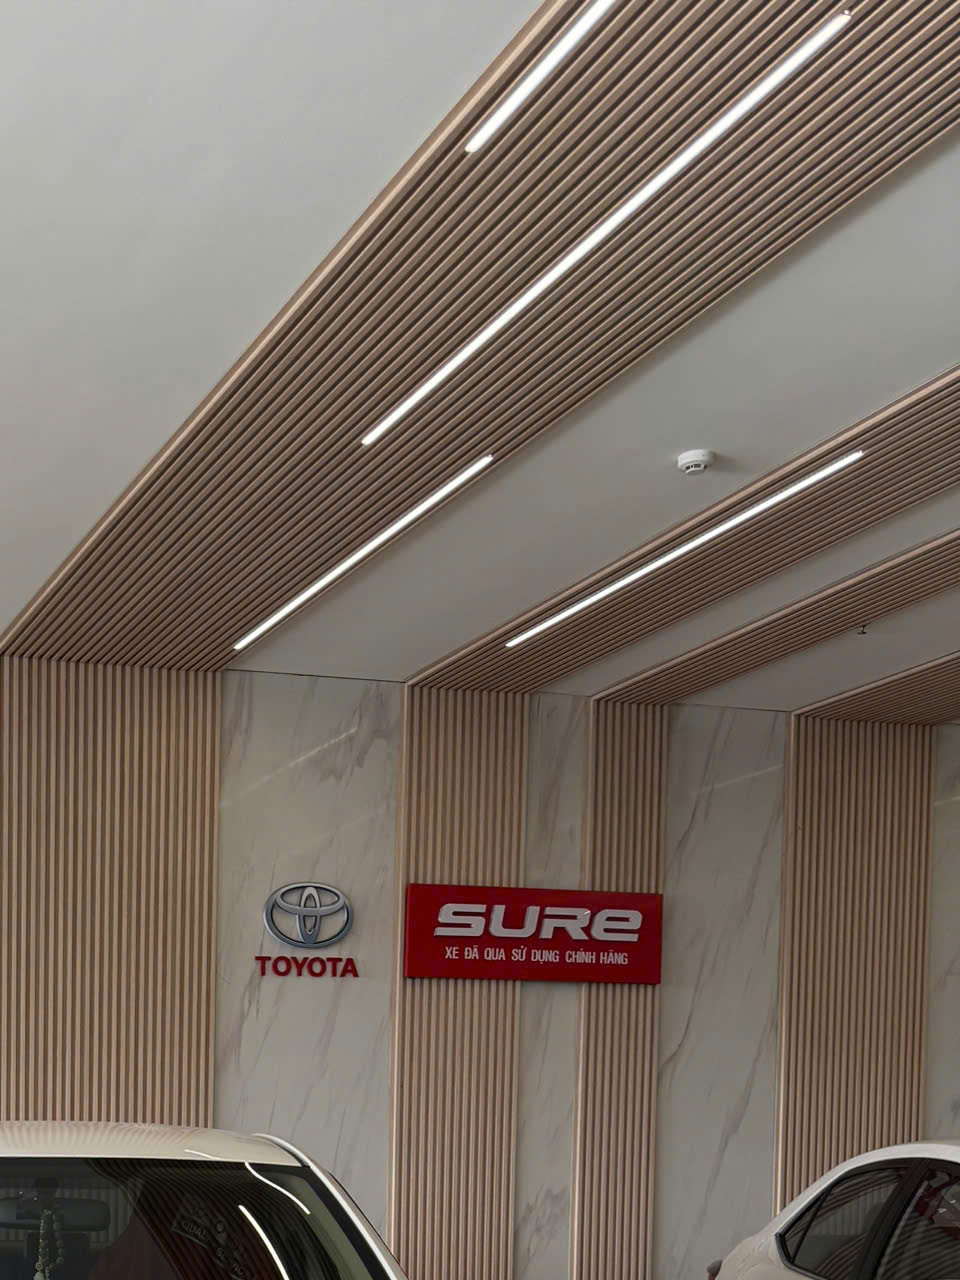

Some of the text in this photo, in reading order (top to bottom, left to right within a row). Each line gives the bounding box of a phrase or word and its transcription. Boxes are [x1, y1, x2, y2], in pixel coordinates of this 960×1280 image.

[434, 902, 643, 942] SURE
[255, 955, 359, 978] TOYOTA
[445, 945, 629, 965] XE ĐÃ QUA SỬ DỤNG CHÍNH HÃNG
